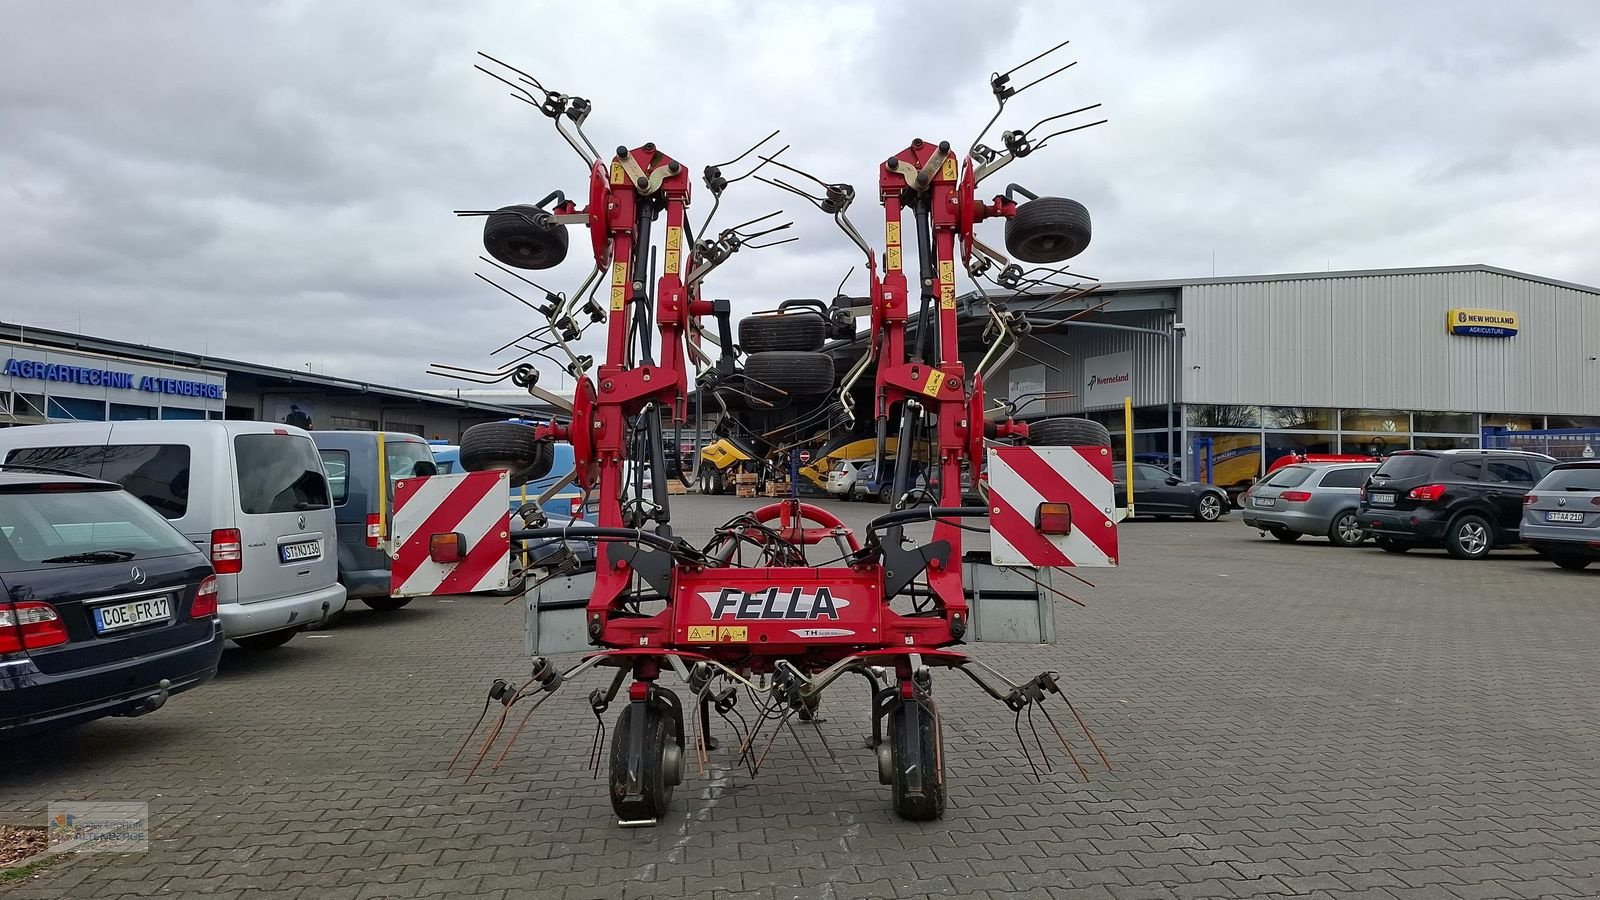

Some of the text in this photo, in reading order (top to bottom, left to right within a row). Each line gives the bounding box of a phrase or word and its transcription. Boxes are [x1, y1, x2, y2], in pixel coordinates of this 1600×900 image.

[1468, 315, 1514, 324] NEW HOLLAND
[1469, 327, 1504, 335] AGRICULTURE
[6, 358, 223, 399] AGRARTECHNIK ALTENBERGE
[1096, 373, 1129, 385] Kverneland
[1549, 512, 1557, 520] ST
[286, 543, 319, 558] ST NJ 136
[711, 586, 839, 620] FELLA
[102, 599, 167, 626] COE FR 17
